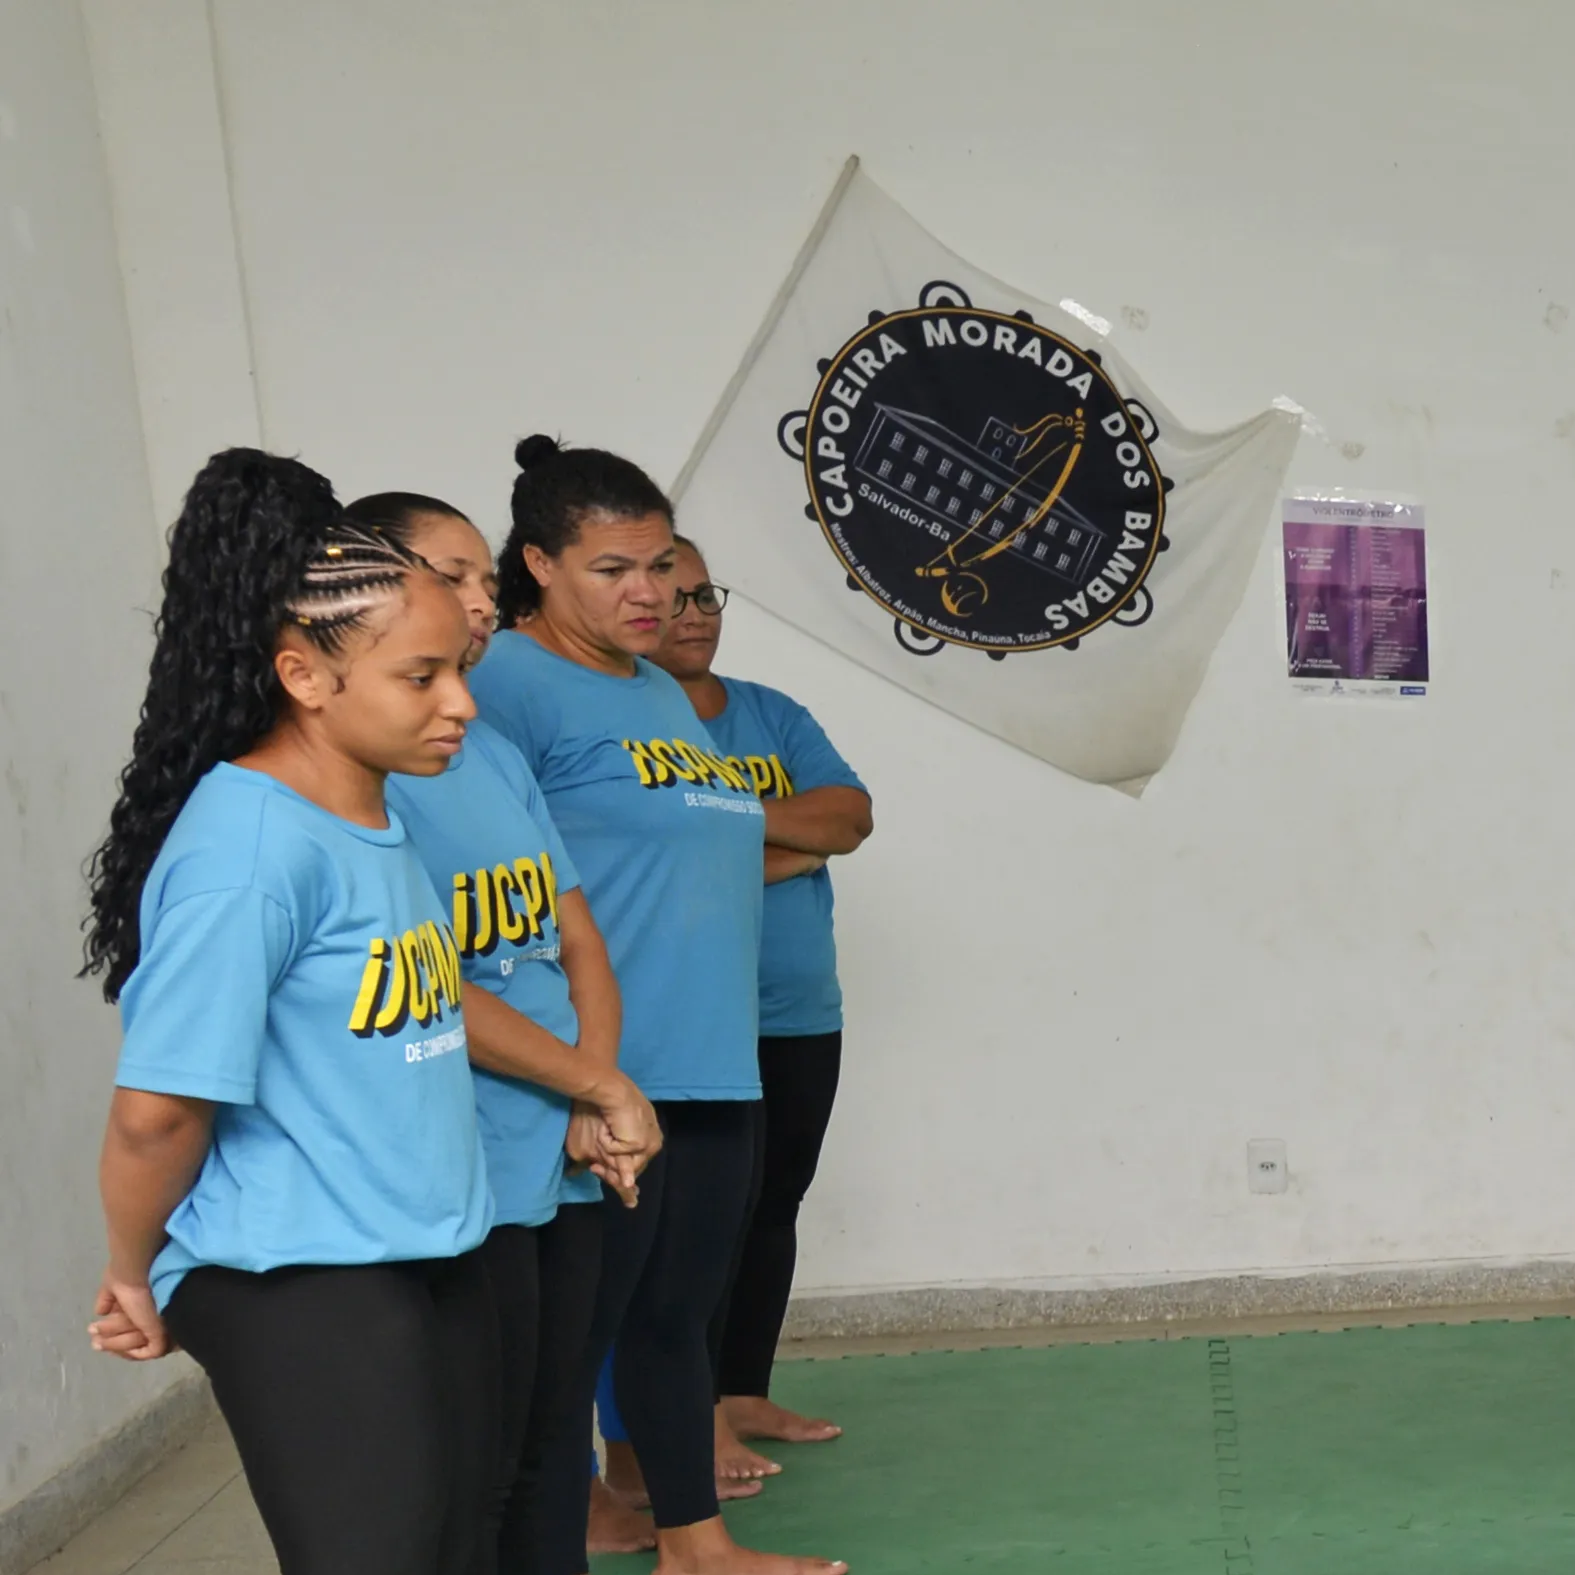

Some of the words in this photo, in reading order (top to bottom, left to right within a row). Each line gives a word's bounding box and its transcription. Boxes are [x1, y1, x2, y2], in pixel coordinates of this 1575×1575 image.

[921, 318, 1093, 400] MORADA
[817, 332, 907, 517] CAPOEIRA
[1100, 411, 1150, 490] DOS
[857, 483, 951, 542] Salvador-Ba
[855, 565, 893, 603] Albatroz,
[926, 615, 969, 641] Mancha,
[1017, 630, 1052, 644] Tocaia
[1044, 510, 1152, 630] BAMBAS
[404, 1041, 423, 1064] DE
